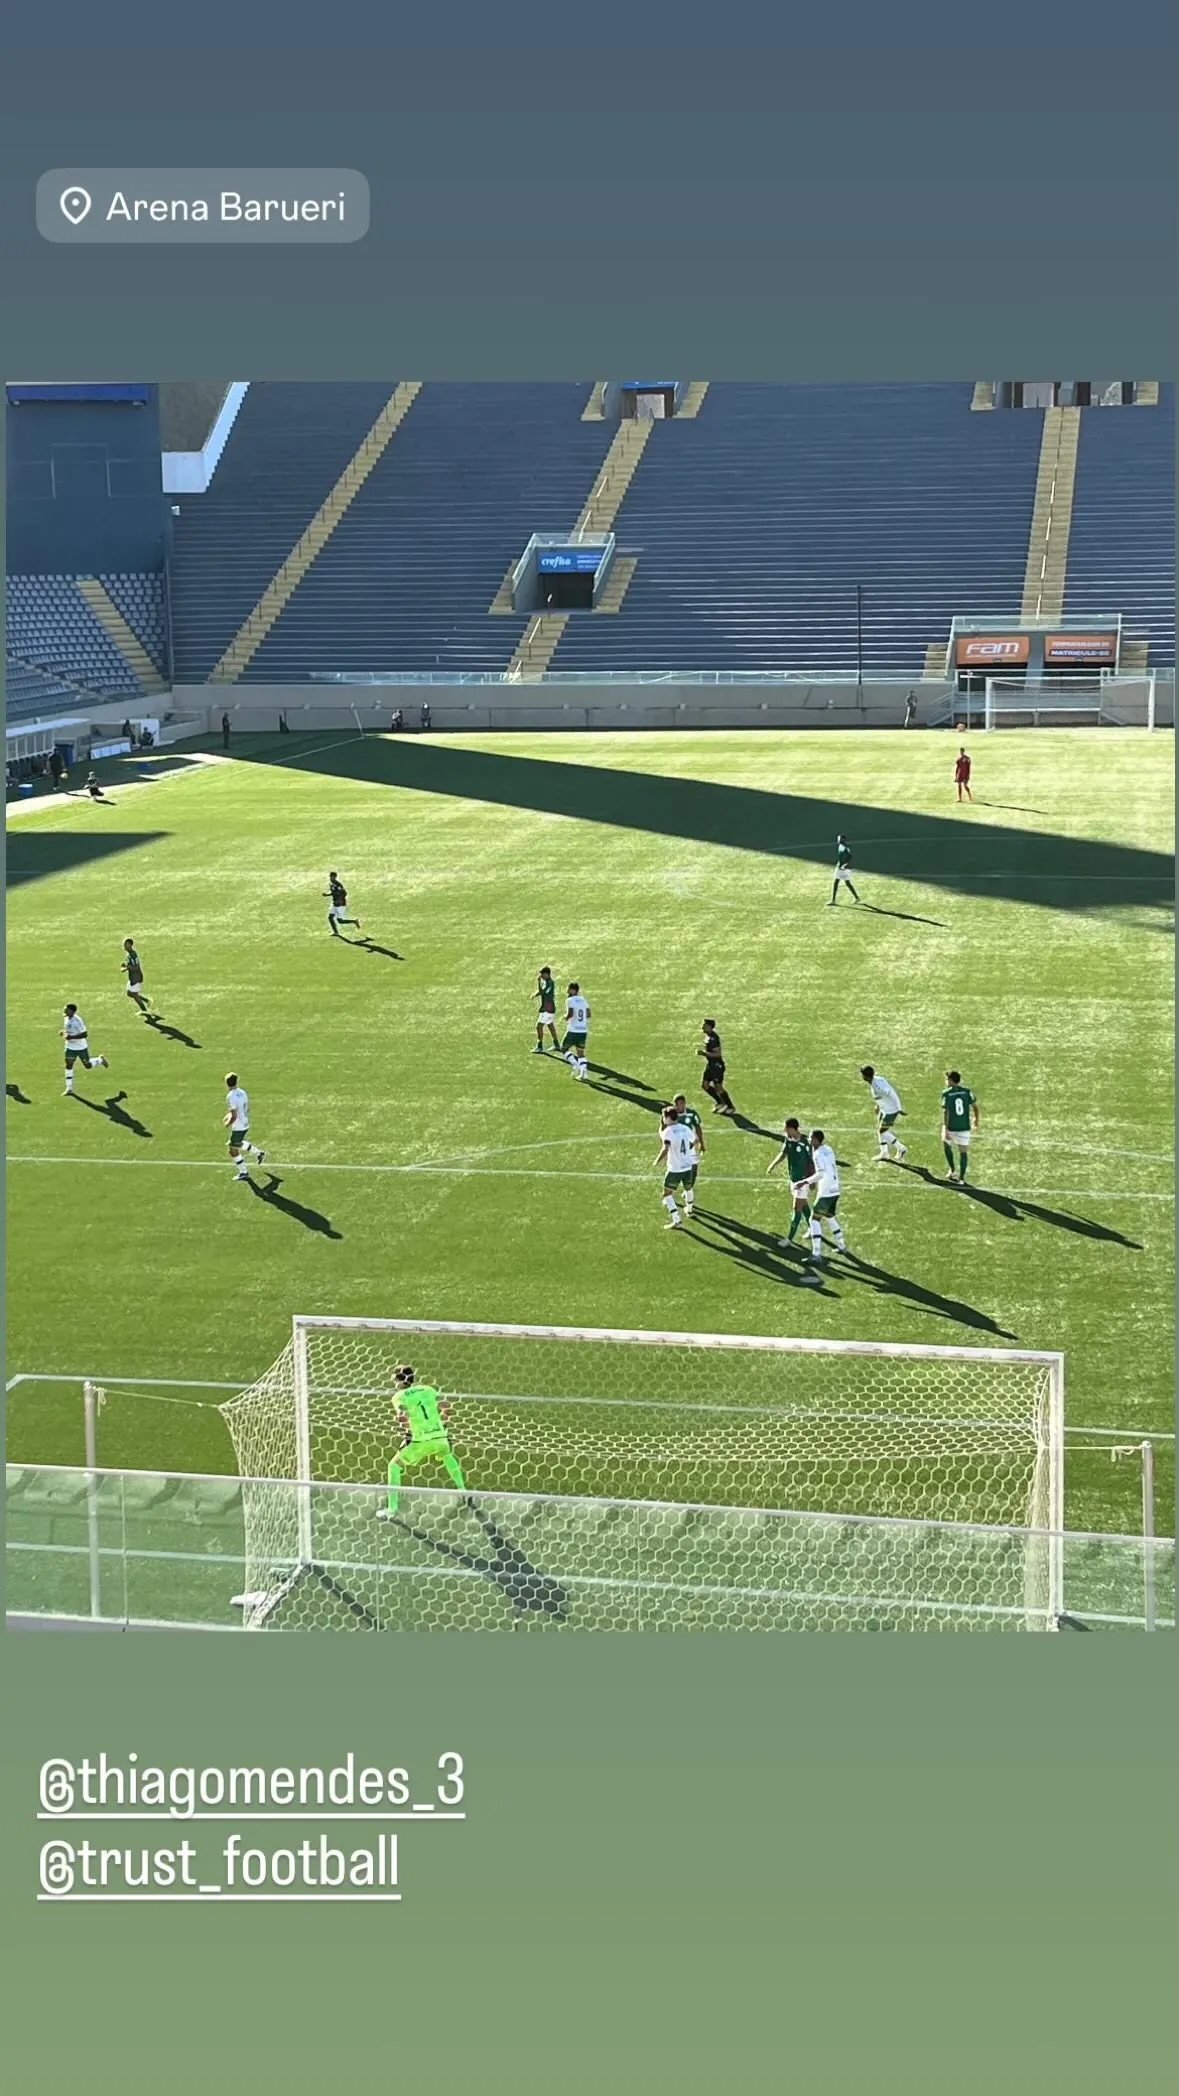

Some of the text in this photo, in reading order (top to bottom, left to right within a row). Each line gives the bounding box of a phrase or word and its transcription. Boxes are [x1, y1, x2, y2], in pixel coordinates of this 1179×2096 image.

[577, 1008, 584, 1023] 9
[954, 1097, 964, 1116] 8
[679, 1138, 687, 1156] 4
[416, 1400, 429, 1421] 1
